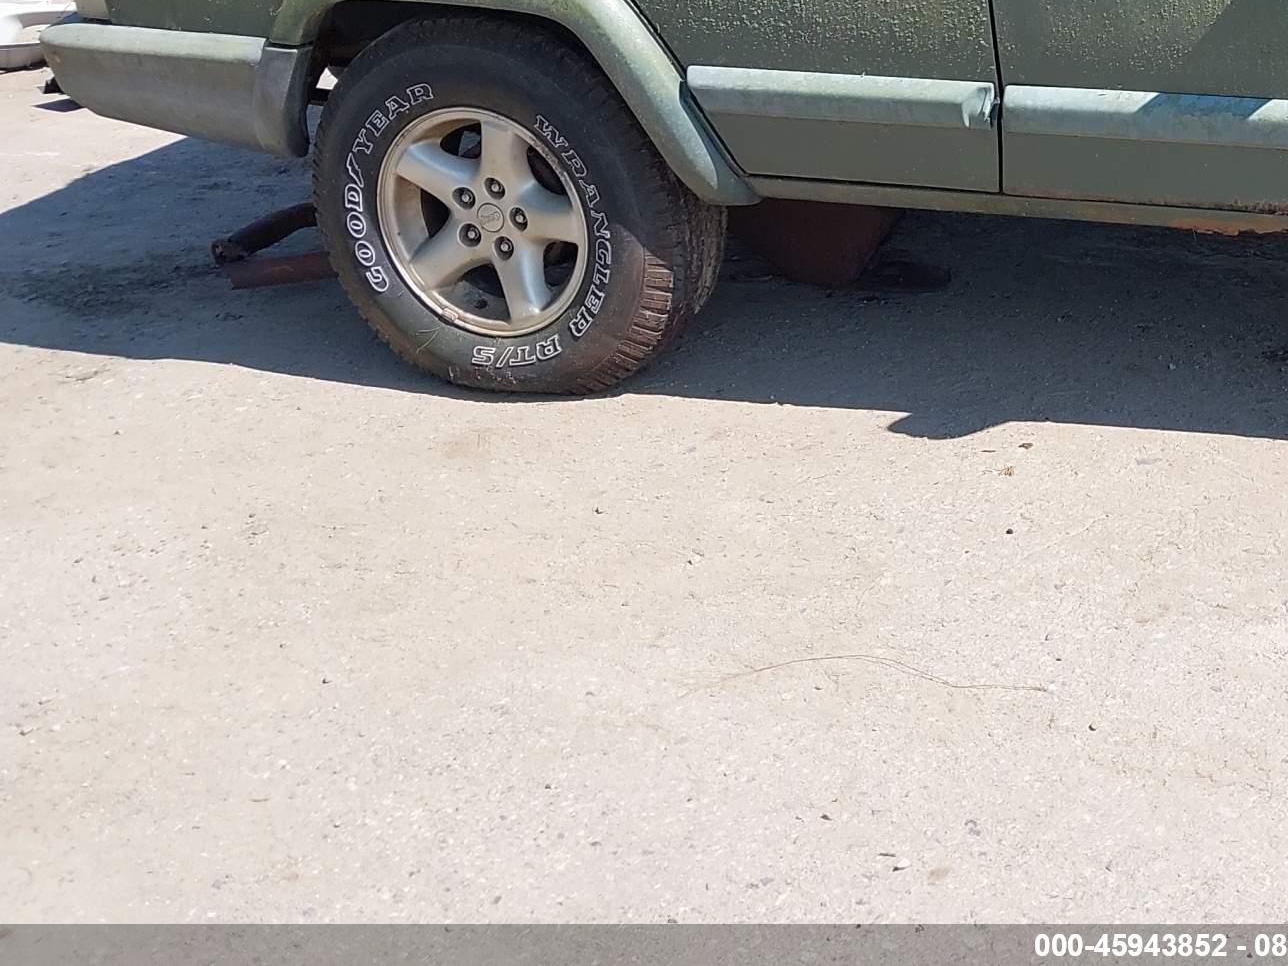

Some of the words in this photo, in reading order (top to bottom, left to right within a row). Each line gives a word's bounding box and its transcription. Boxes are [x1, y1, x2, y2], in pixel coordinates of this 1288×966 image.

[344, 82, 434, 293] GOODYEAR
[533, 114, 612, 338] WRANGLER
[471, 335, 563, 369] RT/S
